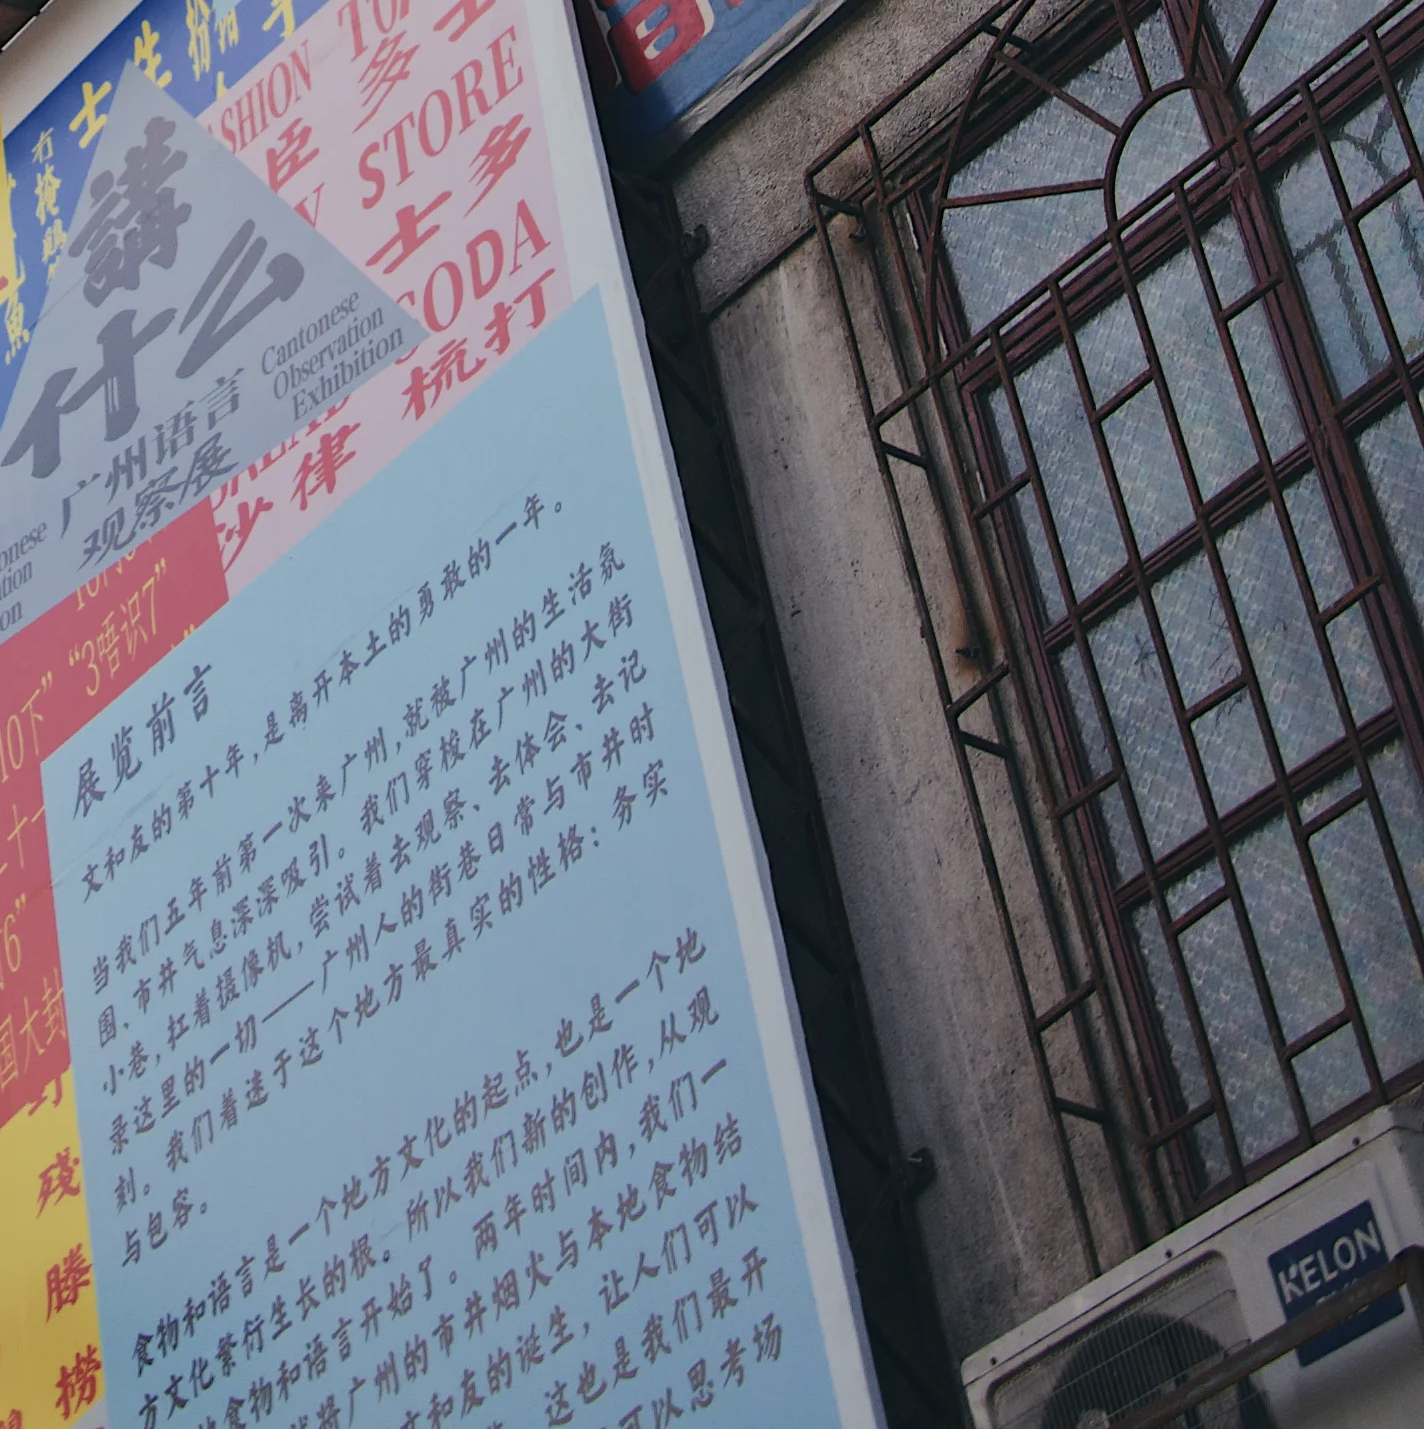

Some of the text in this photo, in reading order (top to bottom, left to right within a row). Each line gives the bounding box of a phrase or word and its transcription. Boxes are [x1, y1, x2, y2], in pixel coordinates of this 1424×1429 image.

[357, 24, 526, 210] STORE
[260, 290, 360, 376] Cantonese
[273, 306, 384, 400] Observation
[291, 329, 405, 422] Exhibition
[61, 366, 242, 529] 广州语言
[81, 435, 240, 572] 观察展
[73, 663, 213, 821] 展览前言
[120, 1200, 210, 1273] 与包容。
[1277, 1218, 1382, 1307] KELON
